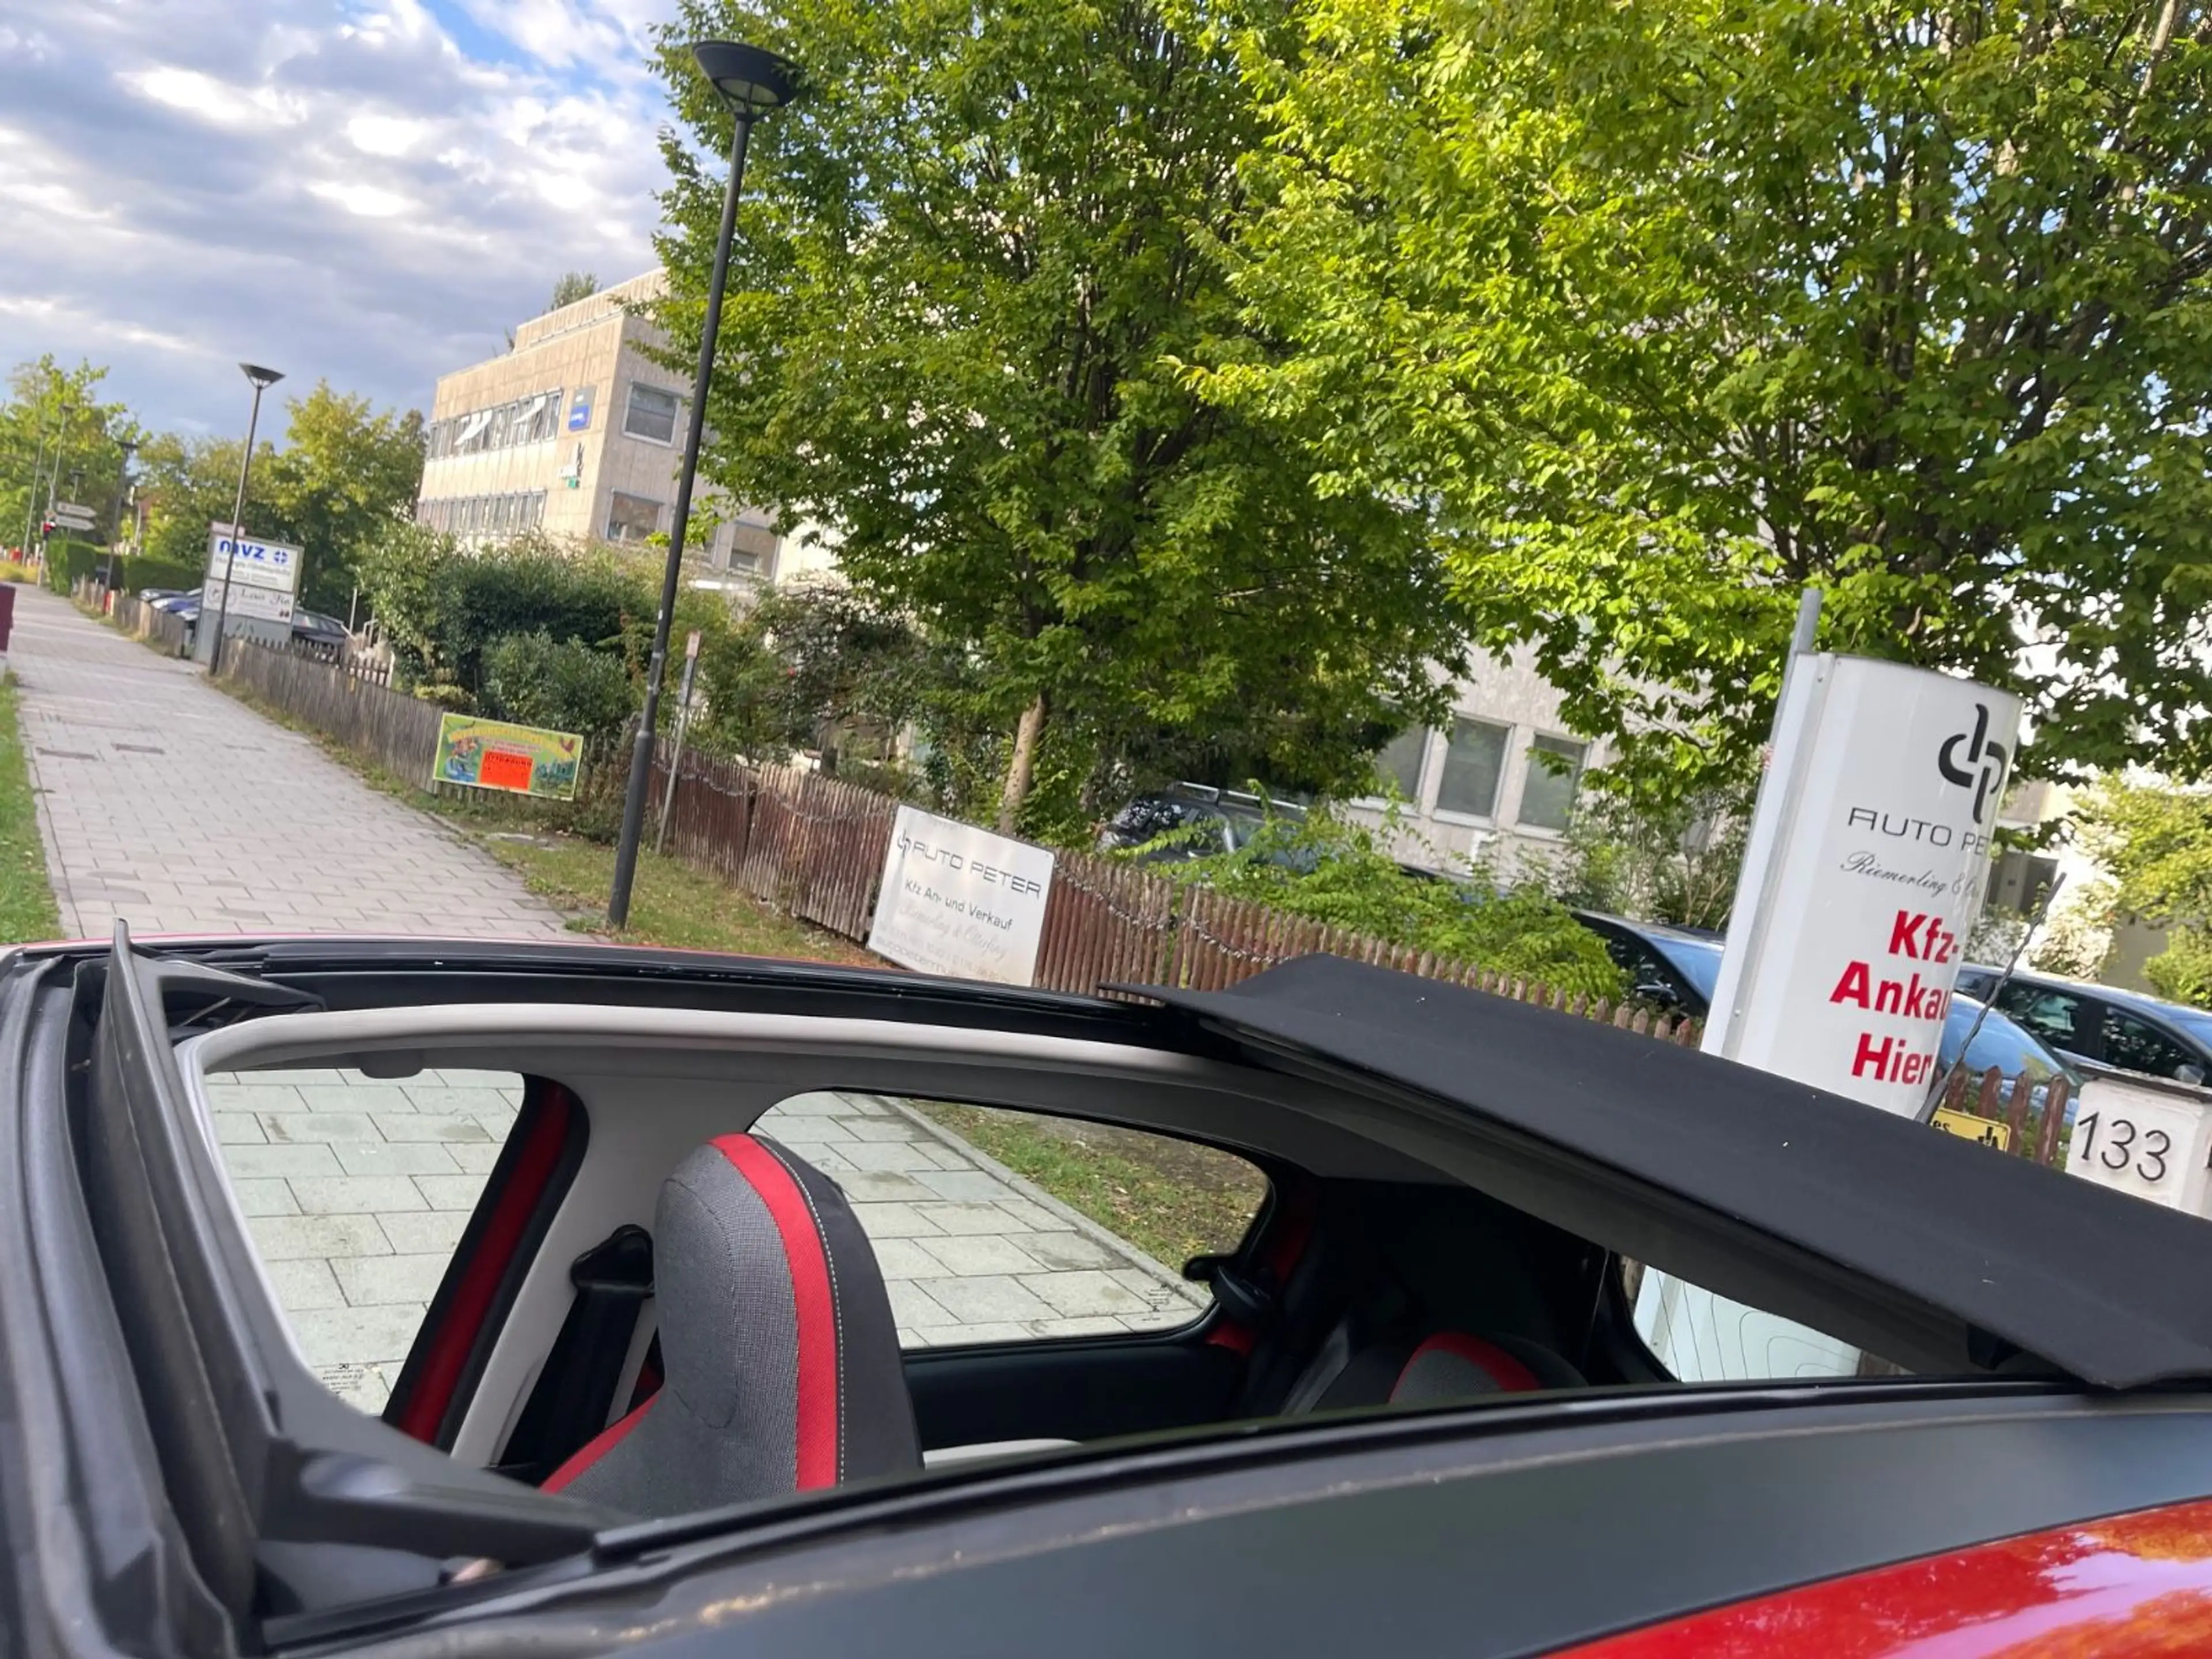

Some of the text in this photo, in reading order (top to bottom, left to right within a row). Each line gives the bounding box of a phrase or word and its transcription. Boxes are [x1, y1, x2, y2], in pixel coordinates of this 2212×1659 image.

[1848, 807, 1952, 847] AUTO
[912, 840, 1041, 899] AUTO PETER
[1840, 850, 1946, 898] Riemerling
[945, 896, 964, 912] und
[969, 904, 1013, 931] Verkauf
[1888, 910, 1959, 964] Kfz-
[1851, 1032, 1933, 1085] Hier
[2078, 1111, 2171, 1181] 133
